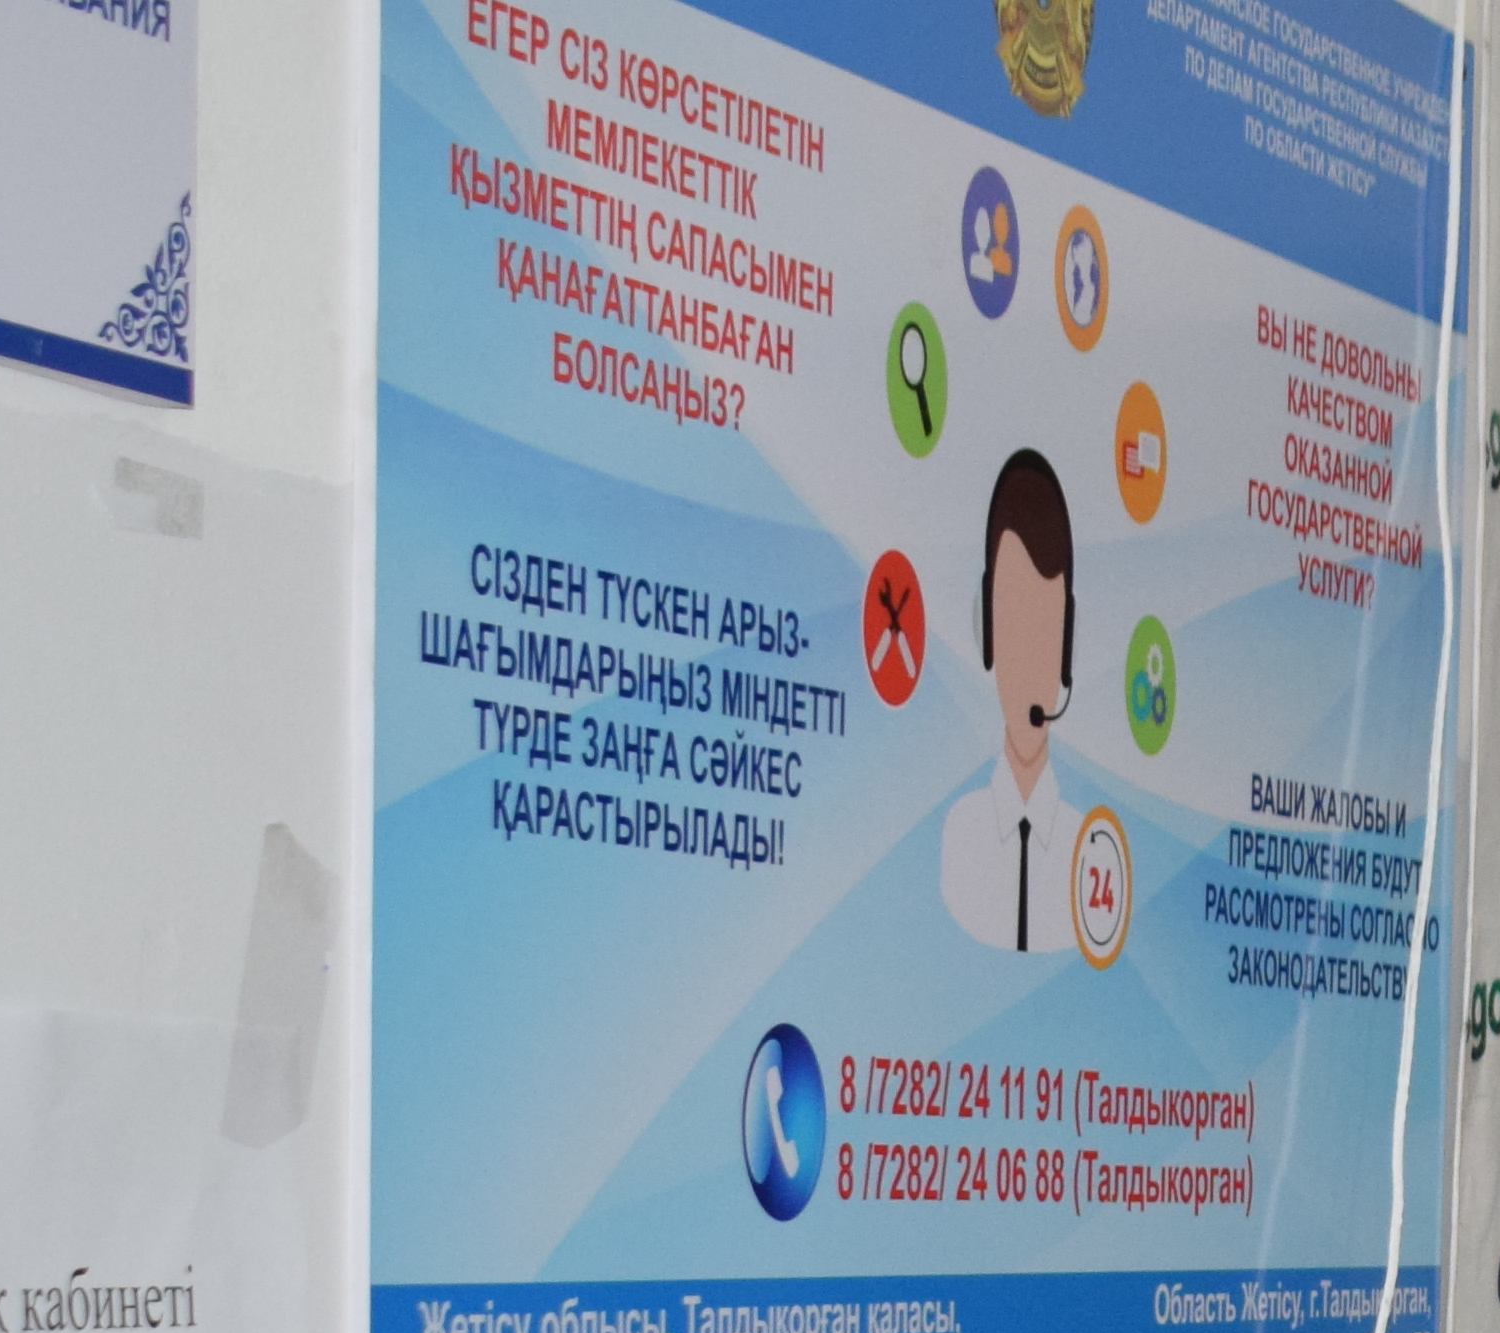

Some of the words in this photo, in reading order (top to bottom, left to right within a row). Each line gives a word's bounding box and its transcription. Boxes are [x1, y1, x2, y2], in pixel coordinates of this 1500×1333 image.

[60, 0, 171, 42] АНИЯ
[1147, 0, 1245, 58] ДЕПАРТАМЕНТ
[468, 0, 550, 65] ЕГЕР
[559, 28, 608, 91] СІЗ
[620, 49, 825, 172] КӨРСЕТІЛЕТІН
[1185, 45, 1205, 80] ПО
[1207, 56, 1252, 102] ДЕЛАМ
[548, 99, 757, 219] МЕМЛЕКЕТТІК
[1244, 114, 1264, 149] ПО
[1267, 127, 1324, 175] ОБЛАСТИ
[451, 143, 637, 263] ҚЫЗМЕТТІҢ
[648, 212, 833, 317] САПАСЫМЕН
[498, 238, 794, 374] ҚАНАҒАТТАНБАҒАН
[554, 332, 745, 431] БОЛСАҢЫЗ?
[1257, 304, 1288, 354] ВЫ
[1294, 319, 1317, 364] НЕ
[1321, 331, 1421, 404] ДОВОЛЬНЫ
[1288, 375, 1392, 447] КАЧЕСТВОМ
[1284, 433, 1392, 504] ОКАЗАННОЙ
[1247, 479, 1422, 569] ГОСУДАРСТВЕННОЙ
[471, 543, 587, 617] СІЗДЕН
[598, 570, 710, 641] ТҮСКЕН
[719, 597, 810, 659] АРЫЗ-
[1298, 552, 1375, 611] УСЛУГИ?
[421, 611, 712, 715] ШАҒЫМДАРЫҢЫЗ
[722, 669, 846, 736] МІНДЕТТІ
[474, 699, 572, 771] ТҮРДЕ
[583, 721, 681, 784] ЗАҢҒА
[690, 731, 803, 798] СӘЙКЕС
[493, 779, 785, 871] ҚАРАСТЫРЫЛАДЫ!
[1251, 773, 1305, 820] ВАШИ
[1311, 785, 1390, 837] ЖАЛОБЫ
[1394, 802, 1406, 839] И
[1089, 867, 1114, 912] 24
[1229, 828, 1366, 887] ПРЕДЛОЖЕНИЯ
[1372, 850, 1422, 899] БУДУТ
[1205, 884, 1345, 939] РАССМОТРЕНЫ
[1350, 903, 1440, 952] СОГЛАСО
[841, 1056, 856, 1114] 8
[866, 1056, 950, 1118] /7282/
[959, 1063, 990, 1120] 24
[1000, 1066, 1026, 1120] 11
[1036, 1068, 1063, 1122] 91
[1074, 1070, 1254, 1142] (Талдыкорган)
[838, 1143, 854, 1200] 8
[863, 1143, 948, 1201] /7282/
[956, 1146, 988, 1201] 24
[997, 1147, 1027, 1202] 06
[1036, 1148, 1064, 1202] 88
[1074, 1150, 1253, 1217] (Талдыкорган)
[21, 1264, 199, 1333] кабинеті
[1154, 1282, 1236, 1325] Область
[1242, 1282, 1304, 1330] Жетісу,
[1310, 1280, 1431, 1324] г.Талдыкрган,
